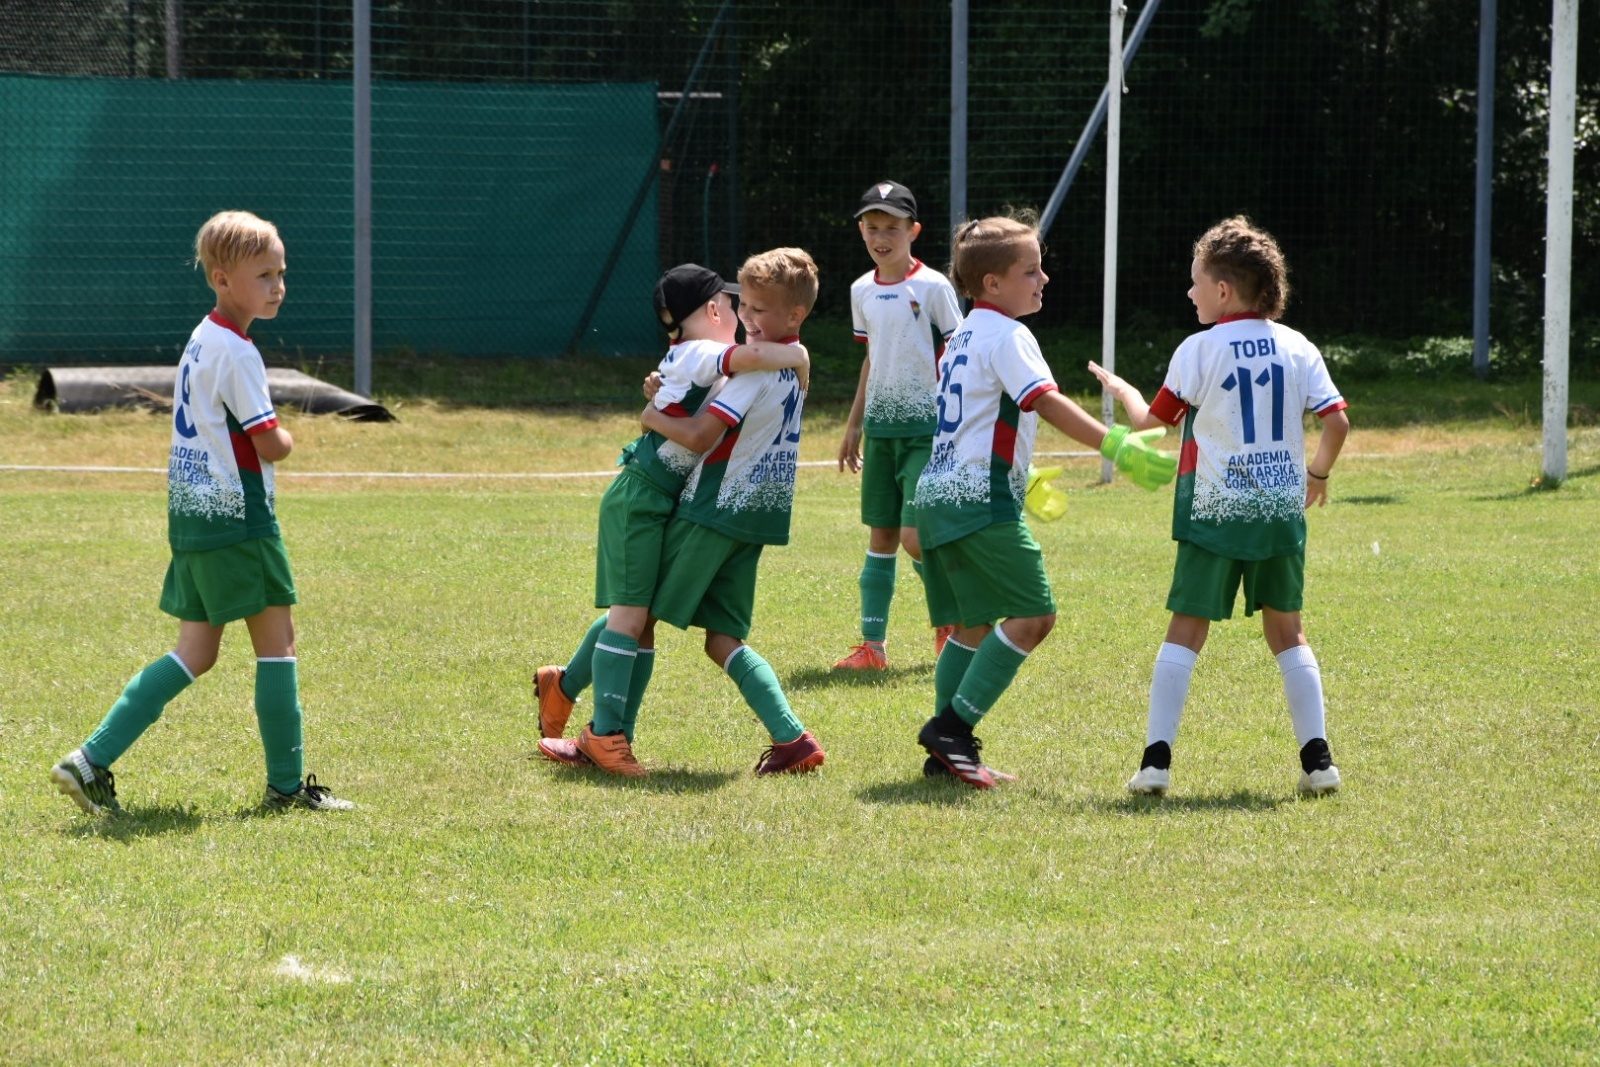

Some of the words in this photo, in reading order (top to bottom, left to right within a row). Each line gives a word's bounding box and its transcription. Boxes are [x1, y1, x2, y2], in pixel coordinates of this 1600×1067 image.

[1229, 338, 1277, 360] TOBI
[1220, 362, 1285, 445] 11
[1228, 449, 1292, 467] AKADEMIA
[1227, 464, 1296, 481] PIŁKARSKA
